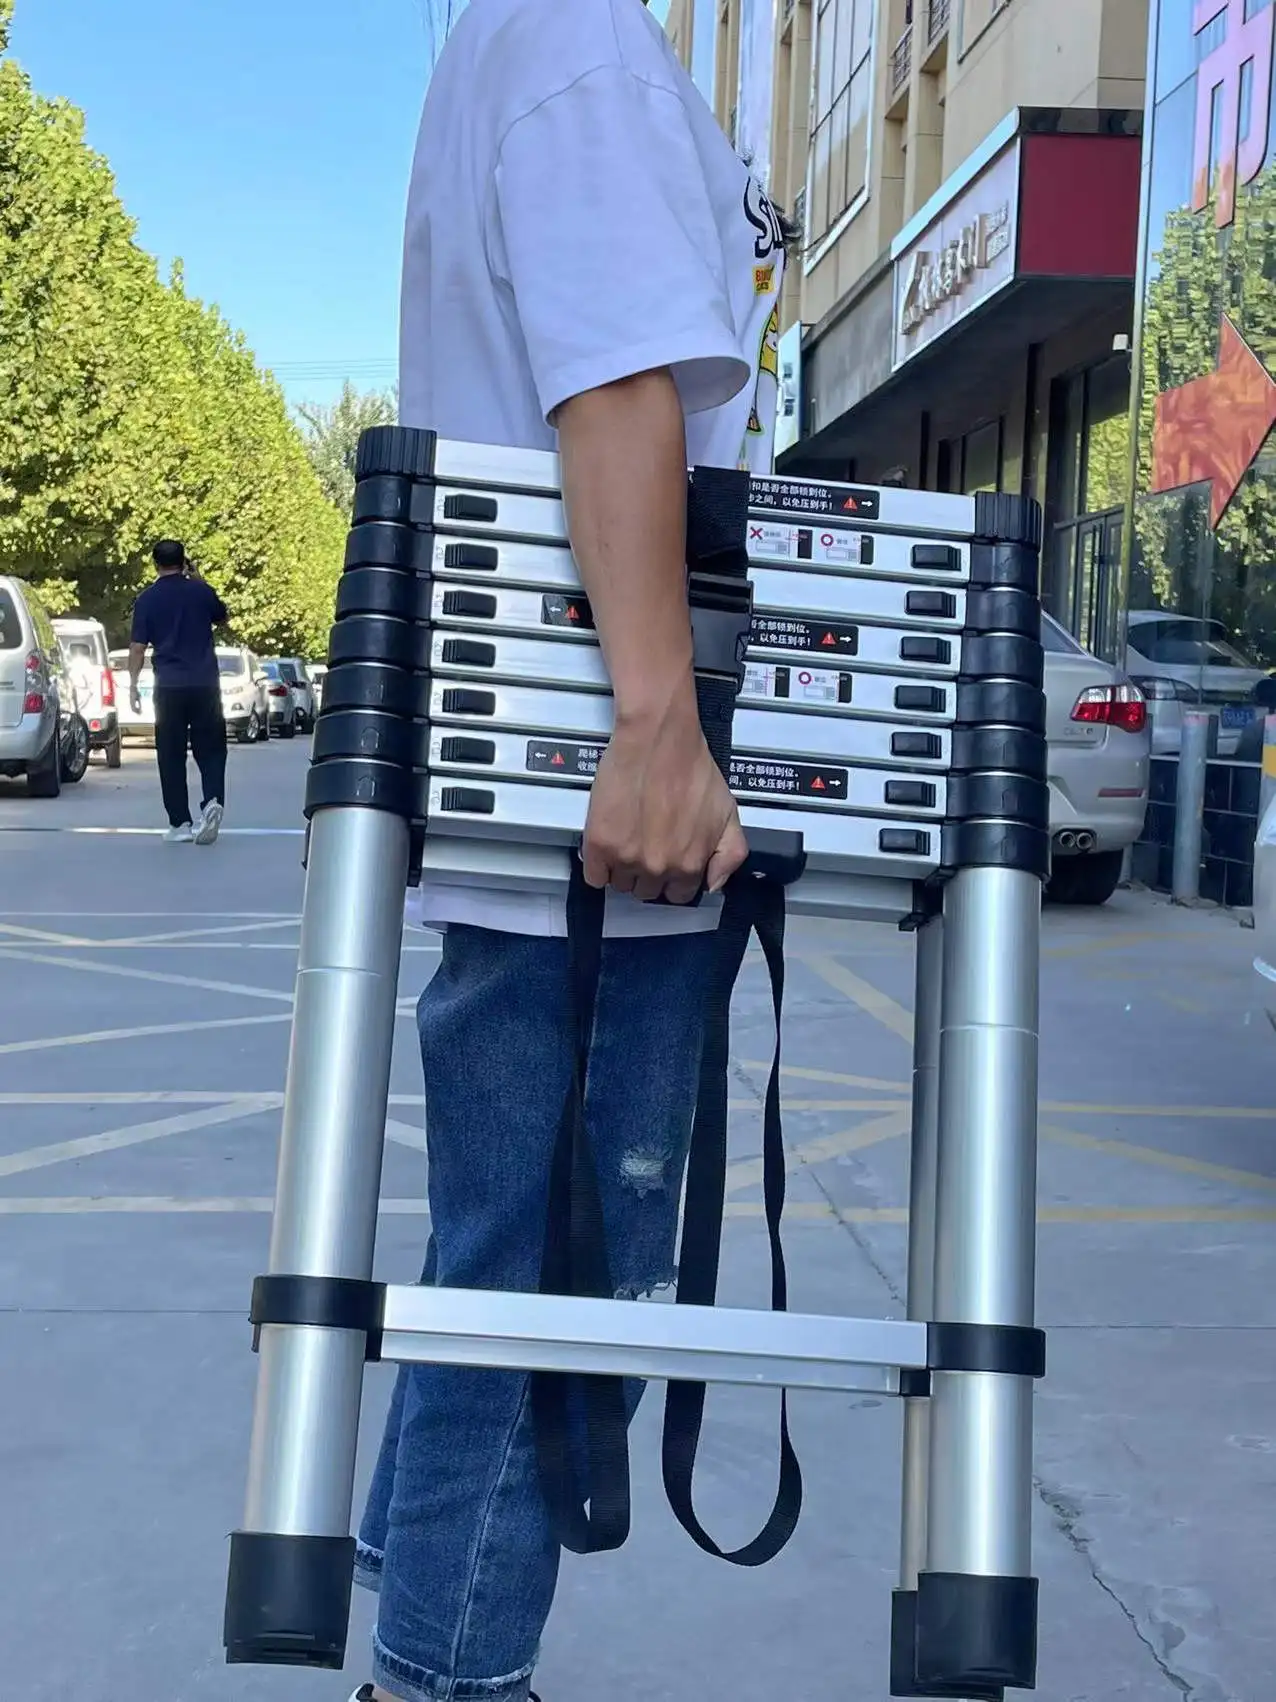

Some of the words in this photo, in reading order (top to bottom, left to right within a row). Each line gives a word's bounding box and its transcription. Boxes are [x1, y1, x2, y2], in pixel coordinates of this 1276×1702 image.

[749, 480, 832, 498] 扣是否全部锁到位。
